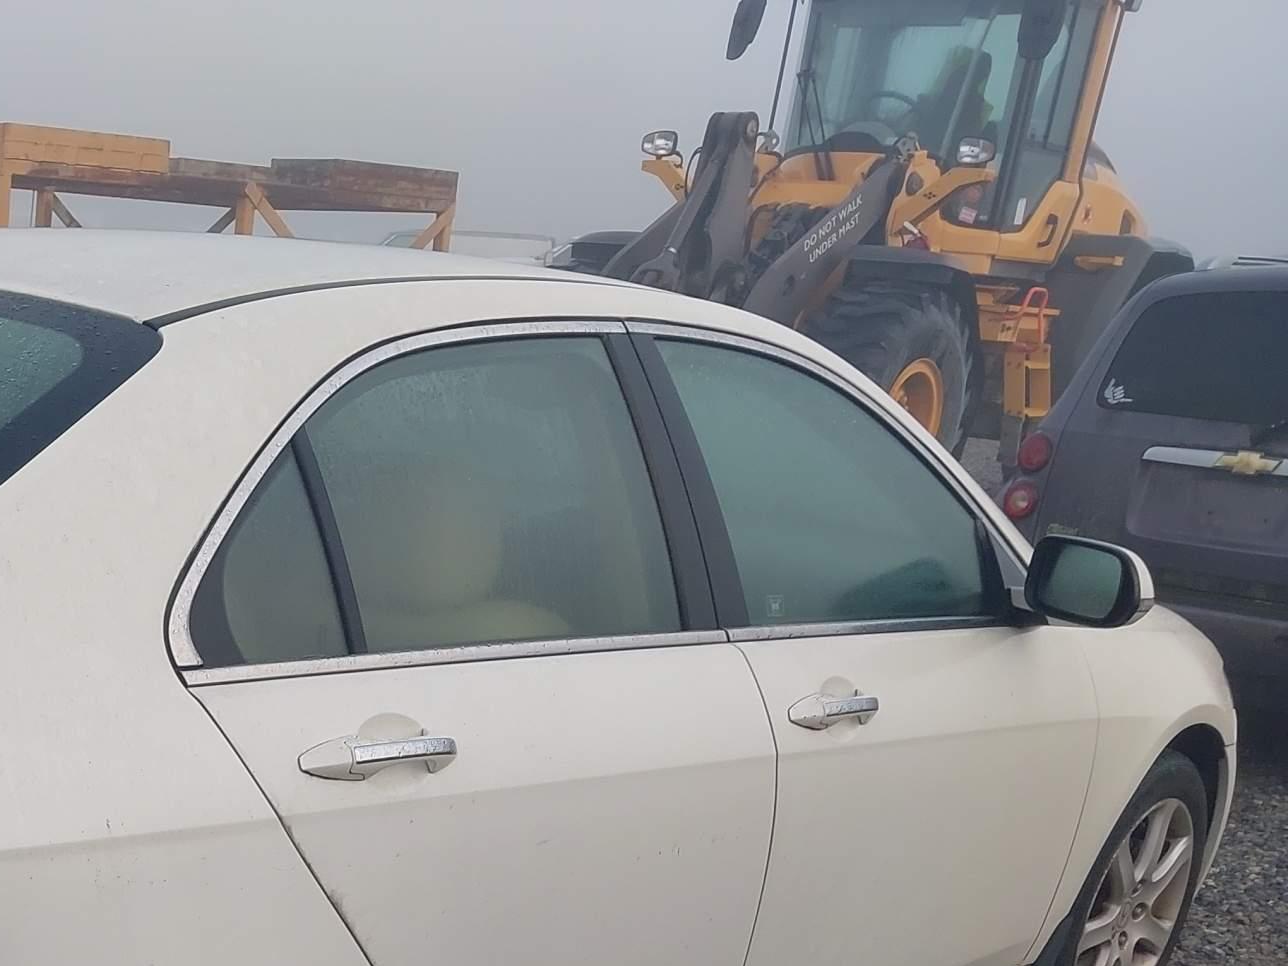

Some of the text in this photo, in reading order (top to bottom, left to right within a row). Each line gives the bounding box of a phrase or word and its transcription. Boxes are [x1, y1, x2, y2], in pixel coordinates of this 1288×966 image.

[804, 193, 862, 251] DO NOT WALK
[809, 211, 860, 263] UNDER MAST
